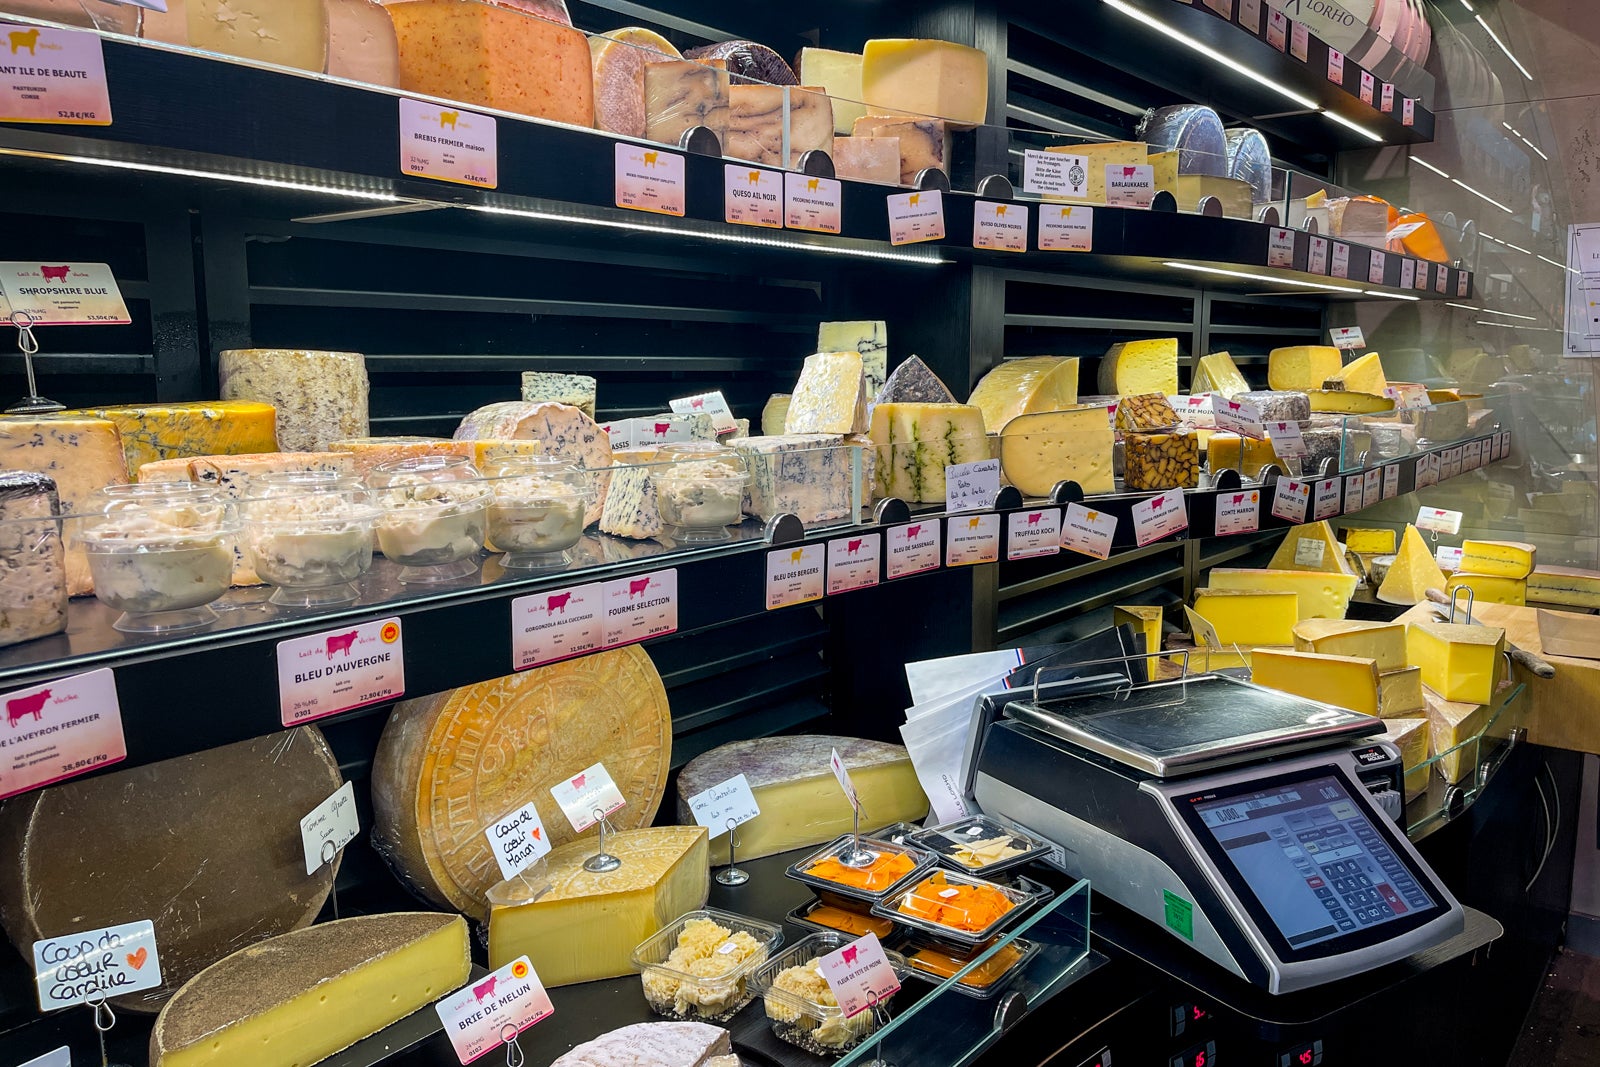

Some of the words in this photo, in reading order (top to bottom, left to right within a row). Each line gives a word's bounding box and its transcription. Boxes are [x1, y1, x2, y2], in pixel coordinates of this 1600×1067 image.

[1306, 0, 1355, 26] LORHO
[20, 67, 35, 76] ILE
[37, 68, 50, 76] DE
[52, 69, 87, 78] BEAUTE
[414, 133, 436, 143] BREBIS
[438, 138, 464, 148] FERMIER
[465, 144, 485, 152] maison
[733, 189, 751, 198] QUESO
[763, 193, 776, 201] NOIR
[912, 540, 934, 549] SASSENAGE
[774, 573, 786, 581] BLEU
[798, 567, 819, 576] BERGERS
[608, 605, 635, 616] FOURME
[636, 596, 670, 610] SELECTION
[525, 619, 556, 632] GORGONZOLA
[557, 617, 568, 626] ALLA
[295, 669, 322, 684] BLEU
[325, 652, 391, 676] D'AUVERGNE
[360, 688, 392, 701] 22,80€/Kg
[295, 709, 311, 718] 0301
[9, 725, 59, 745] L'AVEYRON
[61, 713, 100, 730] FERMIER
[62, 754, 108, 772] 38,80€/Kg
[495, 820, 520, 838] Coup
[520, 810, 532, 824] de
[1349, 879, 1355, 888] 5
[1360, 877, 1368, 885] 6
[837, 976, 850, 986] FLEUR
[869, 959, 882, 969] MOINE
[459, 1012, 483, 1030] BRIE
[484, 1003, 498, 1016] DE
[499, 984, 531, 1007] MELUN
